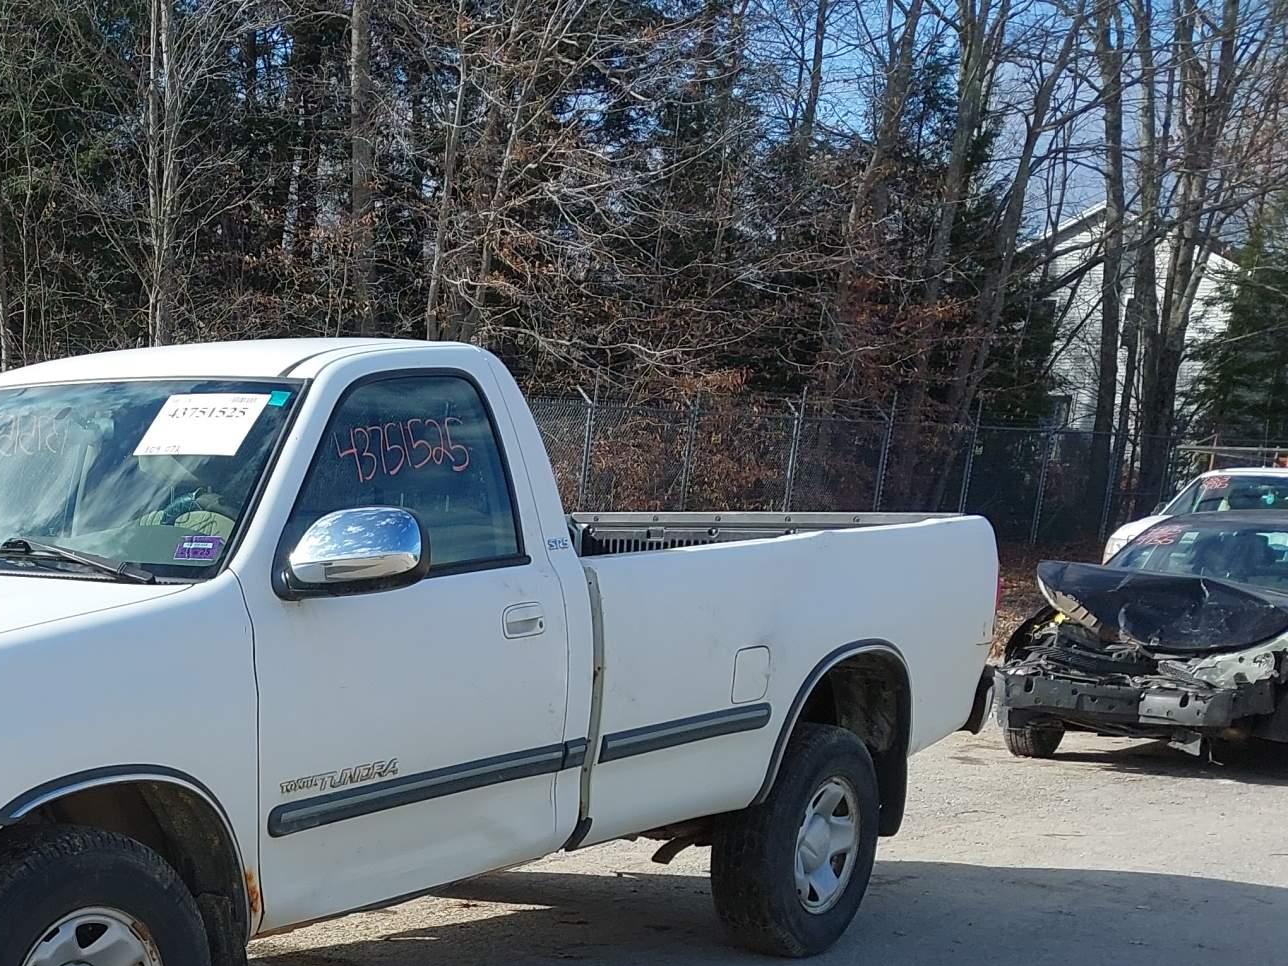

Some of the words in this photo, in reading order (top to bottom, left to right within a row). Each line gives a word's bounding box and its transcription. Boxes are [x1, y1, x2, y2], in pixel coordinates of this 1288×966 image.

[169, 406, 249, 419] 43751525
[332, 416, 470, 483] 43751525
[279, 775, 318, 793] TOYOTA
[317, 757, 399, 791] TUNDRA
